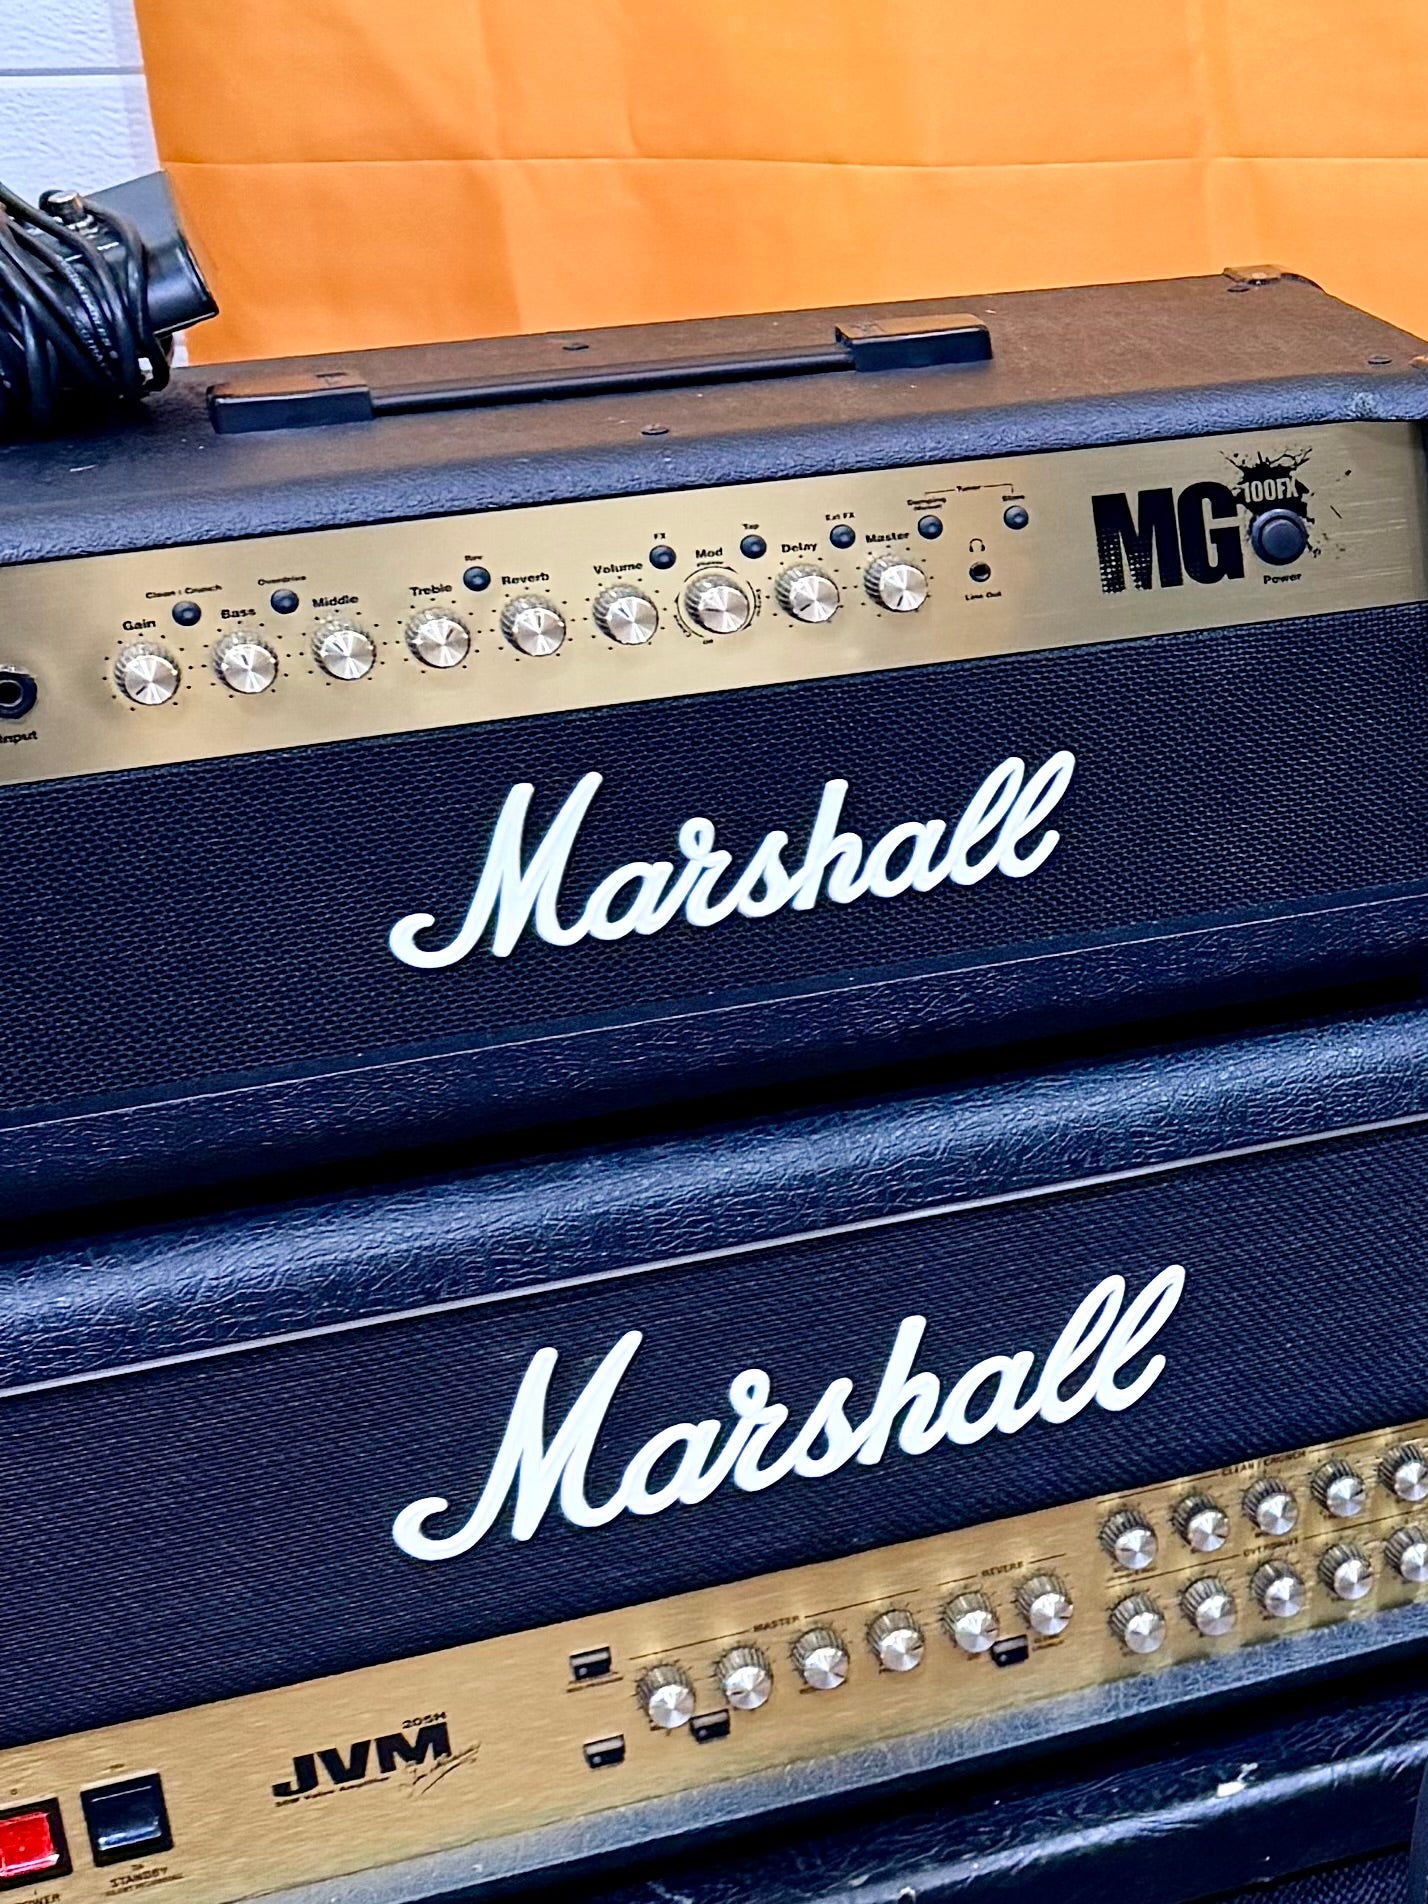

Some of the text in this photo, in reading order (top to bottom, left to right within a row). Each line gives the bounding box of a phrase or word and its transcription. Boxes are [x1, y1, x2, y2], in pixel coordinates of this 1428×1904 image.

[1242, 477, 1300, 503] 100FX
[865, 530, 911, 544] Master
[1092, 481, 1245, 595] MG
[695, 546, 724, 560] Mod
[781, 541, 818, 555] Delay
[593, 560, 644, 576] Volume
[501, 571, 551, 587] Reverb
[1263, 571, 1303, 585] Power
[408, 583, 453, 597] Treble
[312, 594, 360, 609] Middle
[220, 607, 257, 620] Bass
[122, 618, 157, 632] Gain
[389, 750, 1076, 969] Marshall
[392, 1264, 1186, 1561] Marshall
[272, 1722, 452, 1798] JVM
